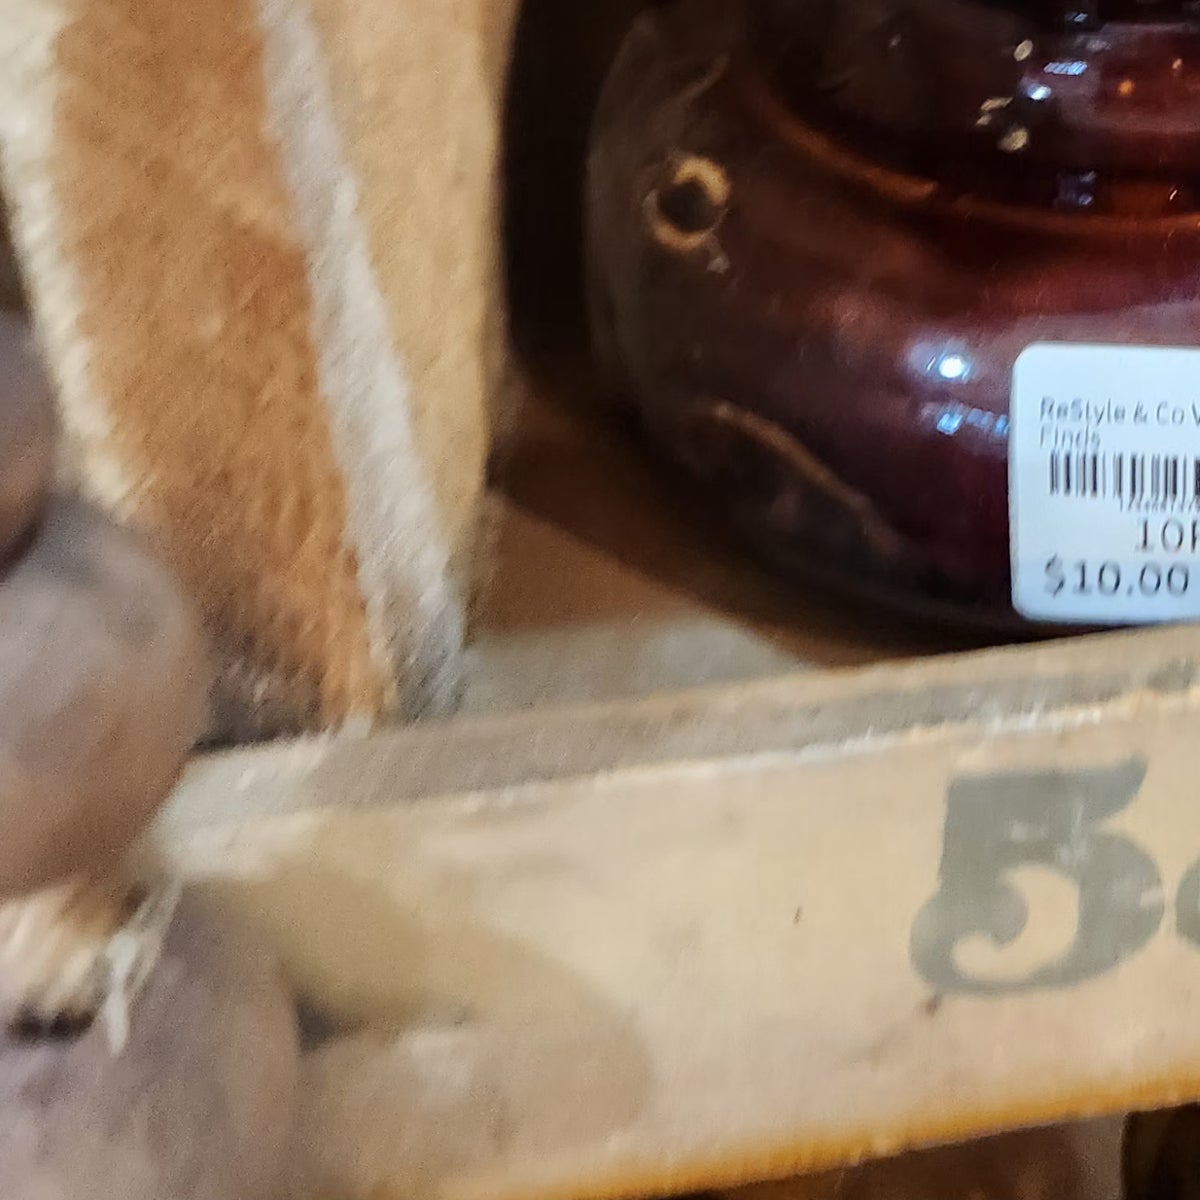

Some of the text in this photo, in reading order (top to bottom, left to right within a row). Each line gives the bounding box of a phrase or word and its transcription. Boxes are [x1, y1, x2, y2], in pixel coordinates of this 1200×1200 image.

[1039, 396, 1126, 425] ReStyle
[1132, 400, 1149, 424] &
[1155, 401, 1185, 426] Co
[1043, 553, 1190, 597] $10.00
